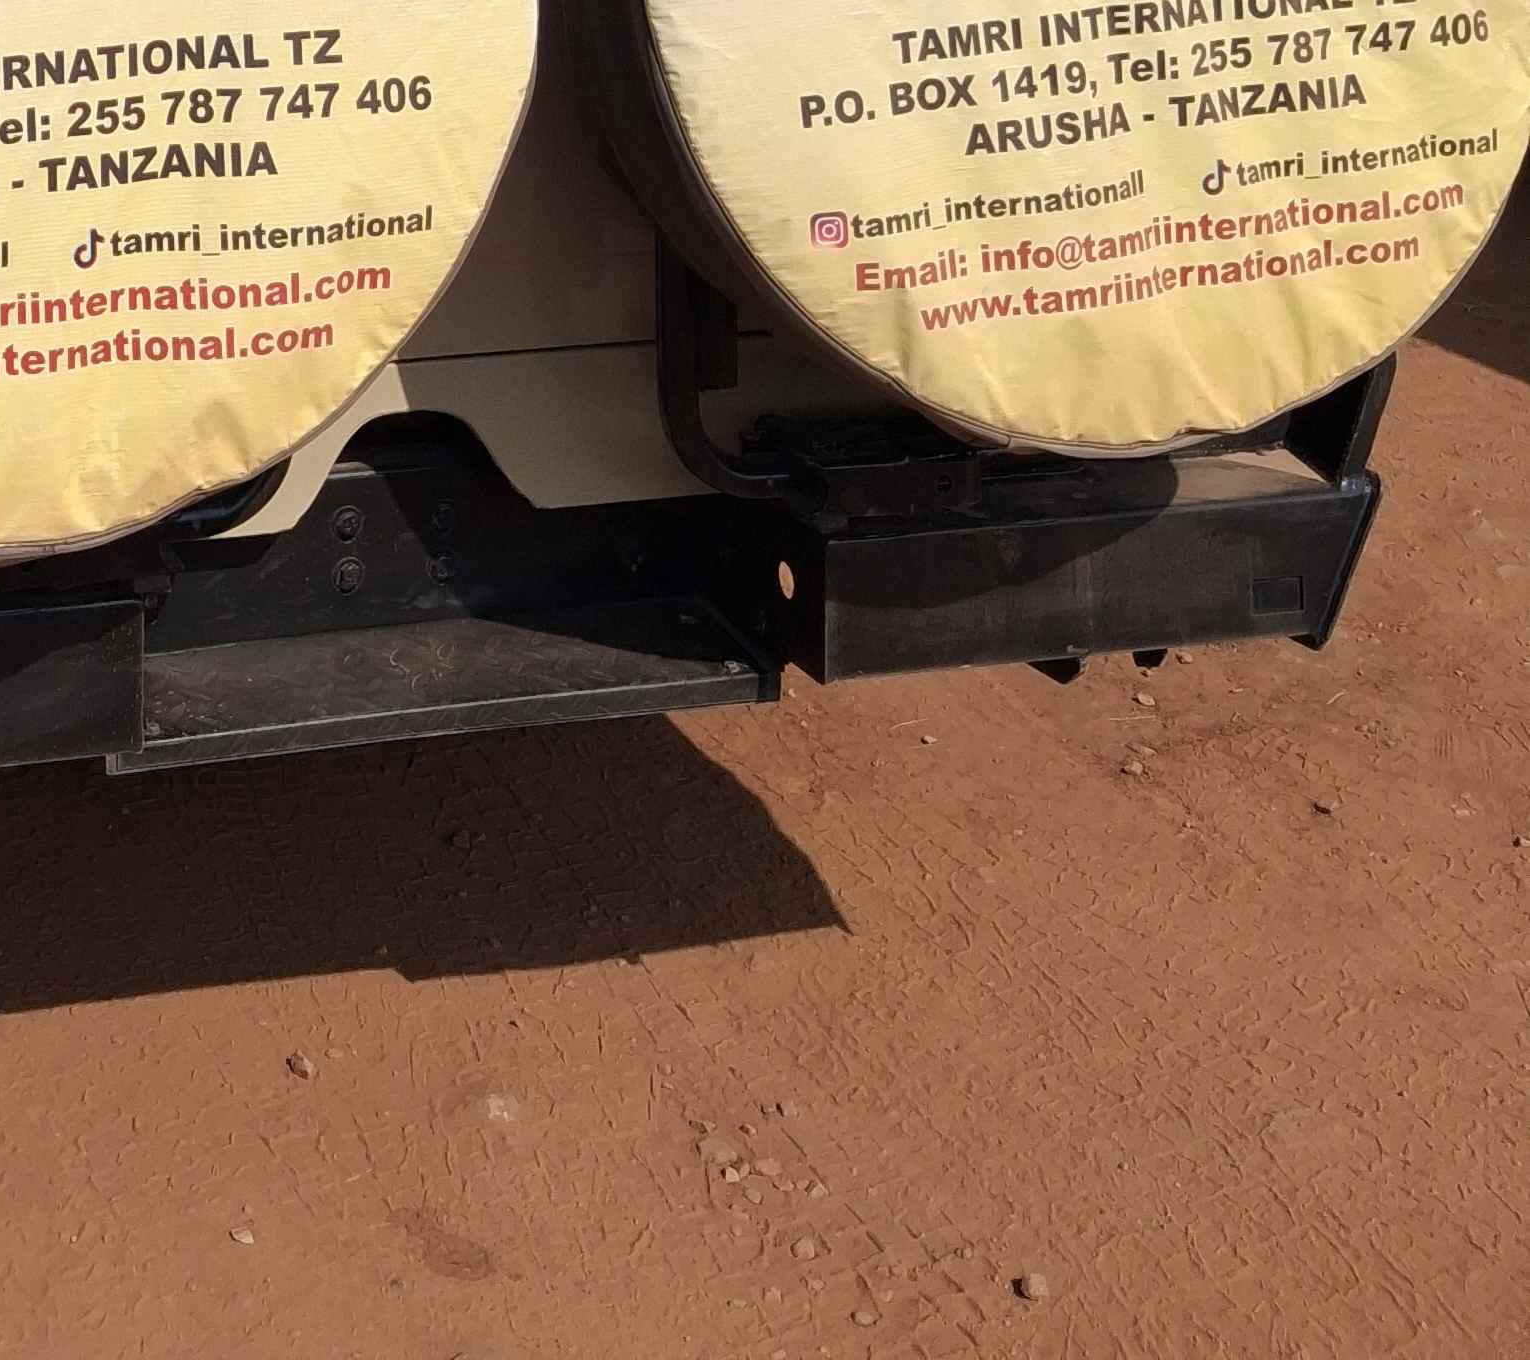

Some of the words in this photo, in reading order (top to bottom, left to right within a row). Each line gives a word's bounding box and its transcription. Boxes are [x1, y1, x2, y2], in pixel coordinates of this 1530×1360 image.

[283, 29, 343, 66] TZ
[800, 90, 876, 129] P.O.
[888, 74, 978, 116] BOX
[991, 60, 1098, 103] 1419,
[1106, 49, 1179, 86] Tel:
[1190, 36, 1253, 78] 255
[1266, 27, 1332, 66] 787
[1344, 19, 1417, 56] 747
[1429, 9, 1489, 47] 406
[892, 17, 1023, 64] TAMRI
[67, 95, 146, 137] 255
[160, 88, 243, 126] 787
[259, 82, 340, 121] 747
[356, 75, 432, 114] 406
[964, 101, 1132, 157] ARUSHA
[1168, 73, 1367, 128] TANZANIA
[38, 141, 279, 193] TANZANIA
[850, 168, 1145, 240] tamri_internationall
[1235, 128, 1498, 187] tamri_international
[111, 205, 433, 257] tamri_international
[854, 247, 969, 292] Email:
[981, 183, 1465, 274] info@tamriinternational.com
[920, 235, 1420, 331] www.tamriinternational.com
